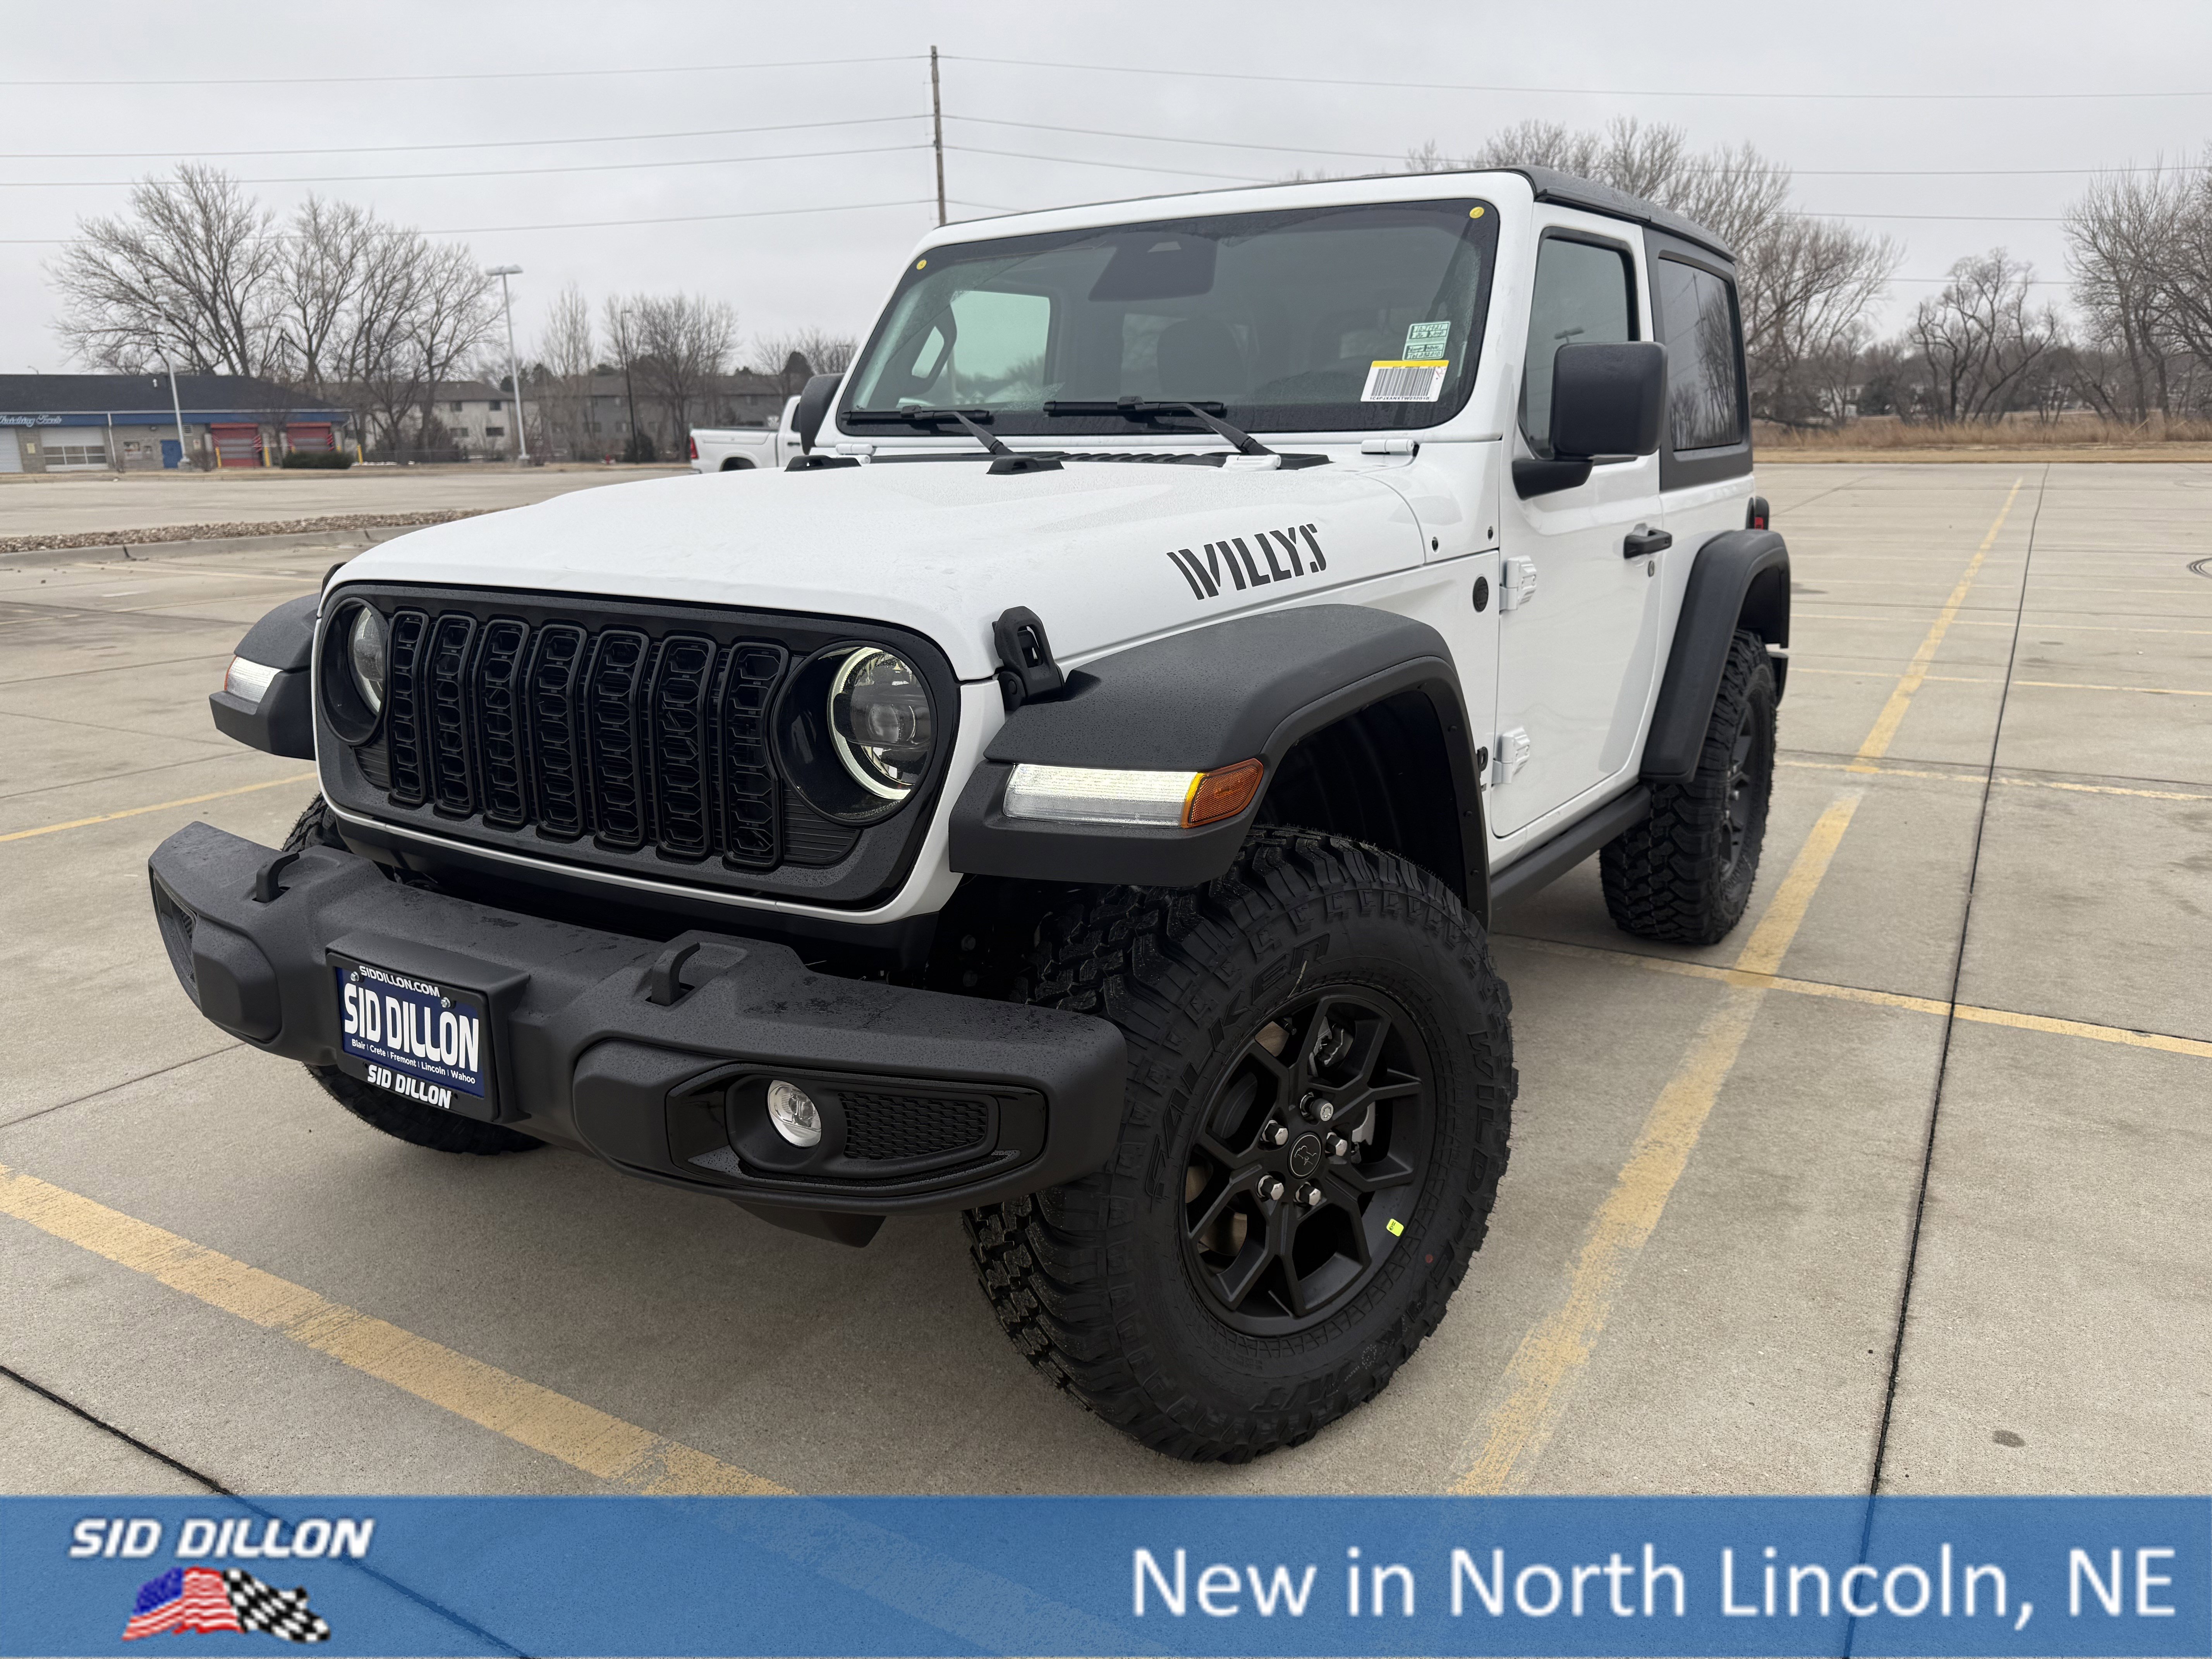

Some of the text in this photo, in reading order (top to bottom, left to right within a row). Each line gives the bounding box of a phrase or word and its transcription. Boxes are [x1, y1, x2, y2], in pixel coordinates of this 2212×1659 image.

[1166, 523, 1327, 600] WILLYS
[360, 966, 440, 997] SIDDILLON.COM
[344, 983, 479, 1073] SID DILLON
[352, 1039, 476, 1084] Blair Crete Fremont Lincoln Wahoo
[367, 1064, 452, 1109] SID DILLON
